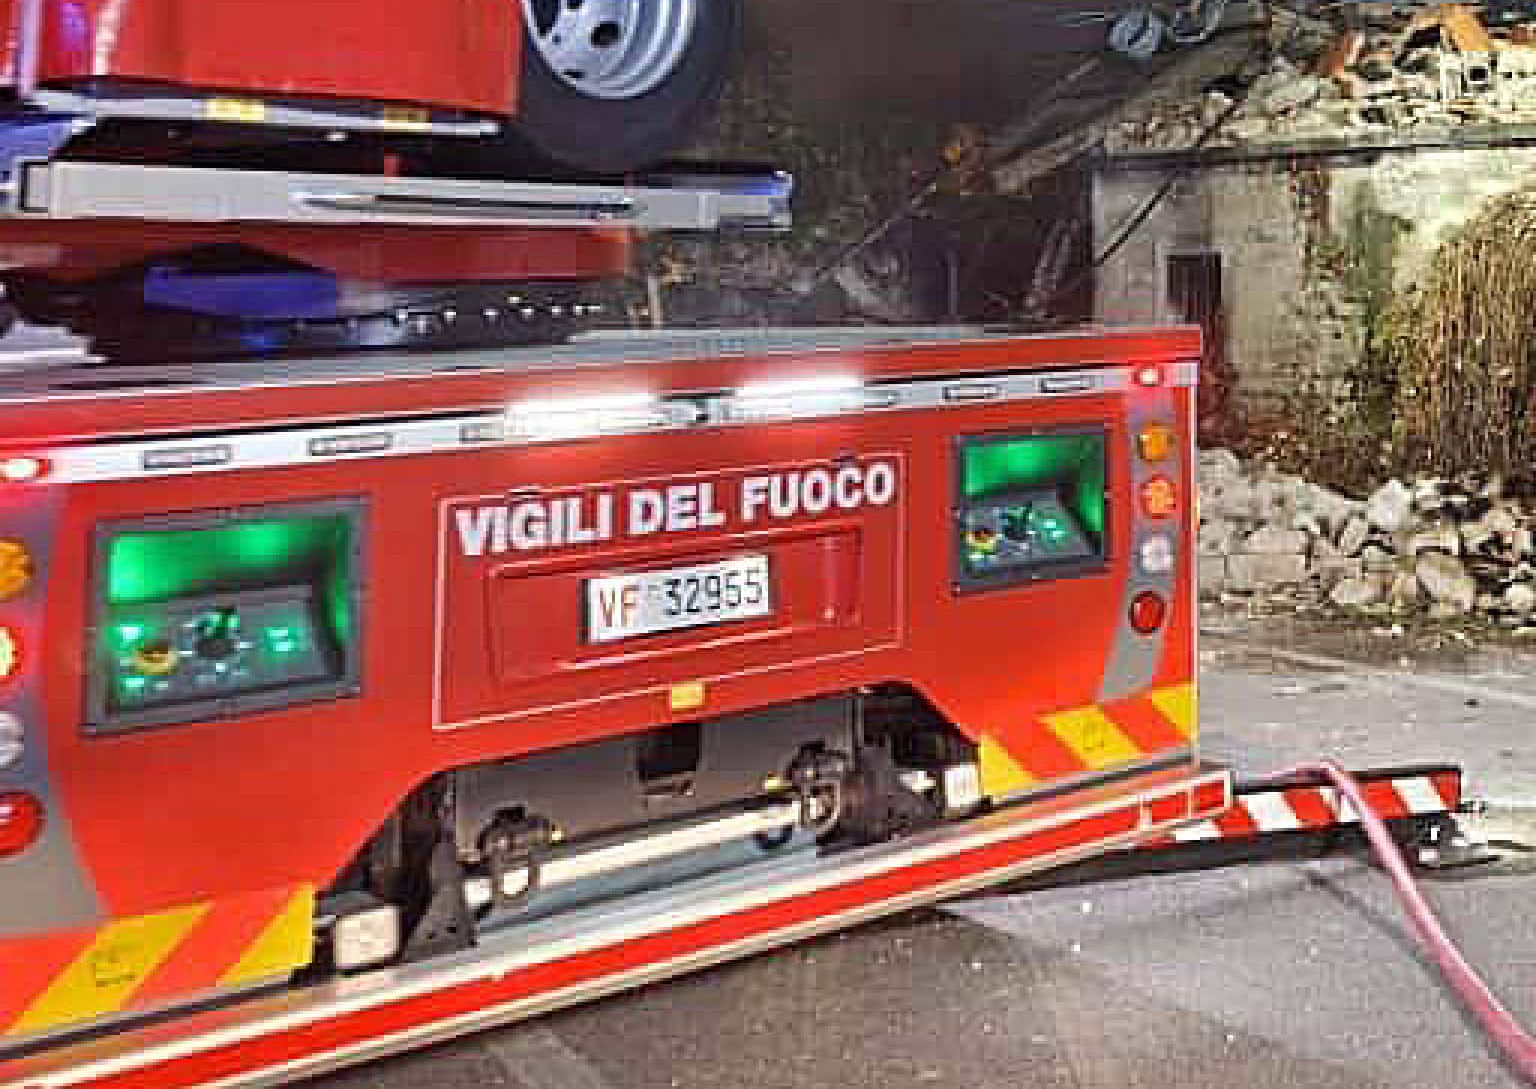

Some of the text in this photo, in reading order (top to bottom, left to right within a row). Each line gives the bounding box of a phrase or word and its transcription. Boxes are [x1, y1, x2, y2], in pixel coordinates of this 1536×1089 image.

[456, 461, 895, 555] VIGILI DEL FUOCO
[599, 585, 640, 629] VF
